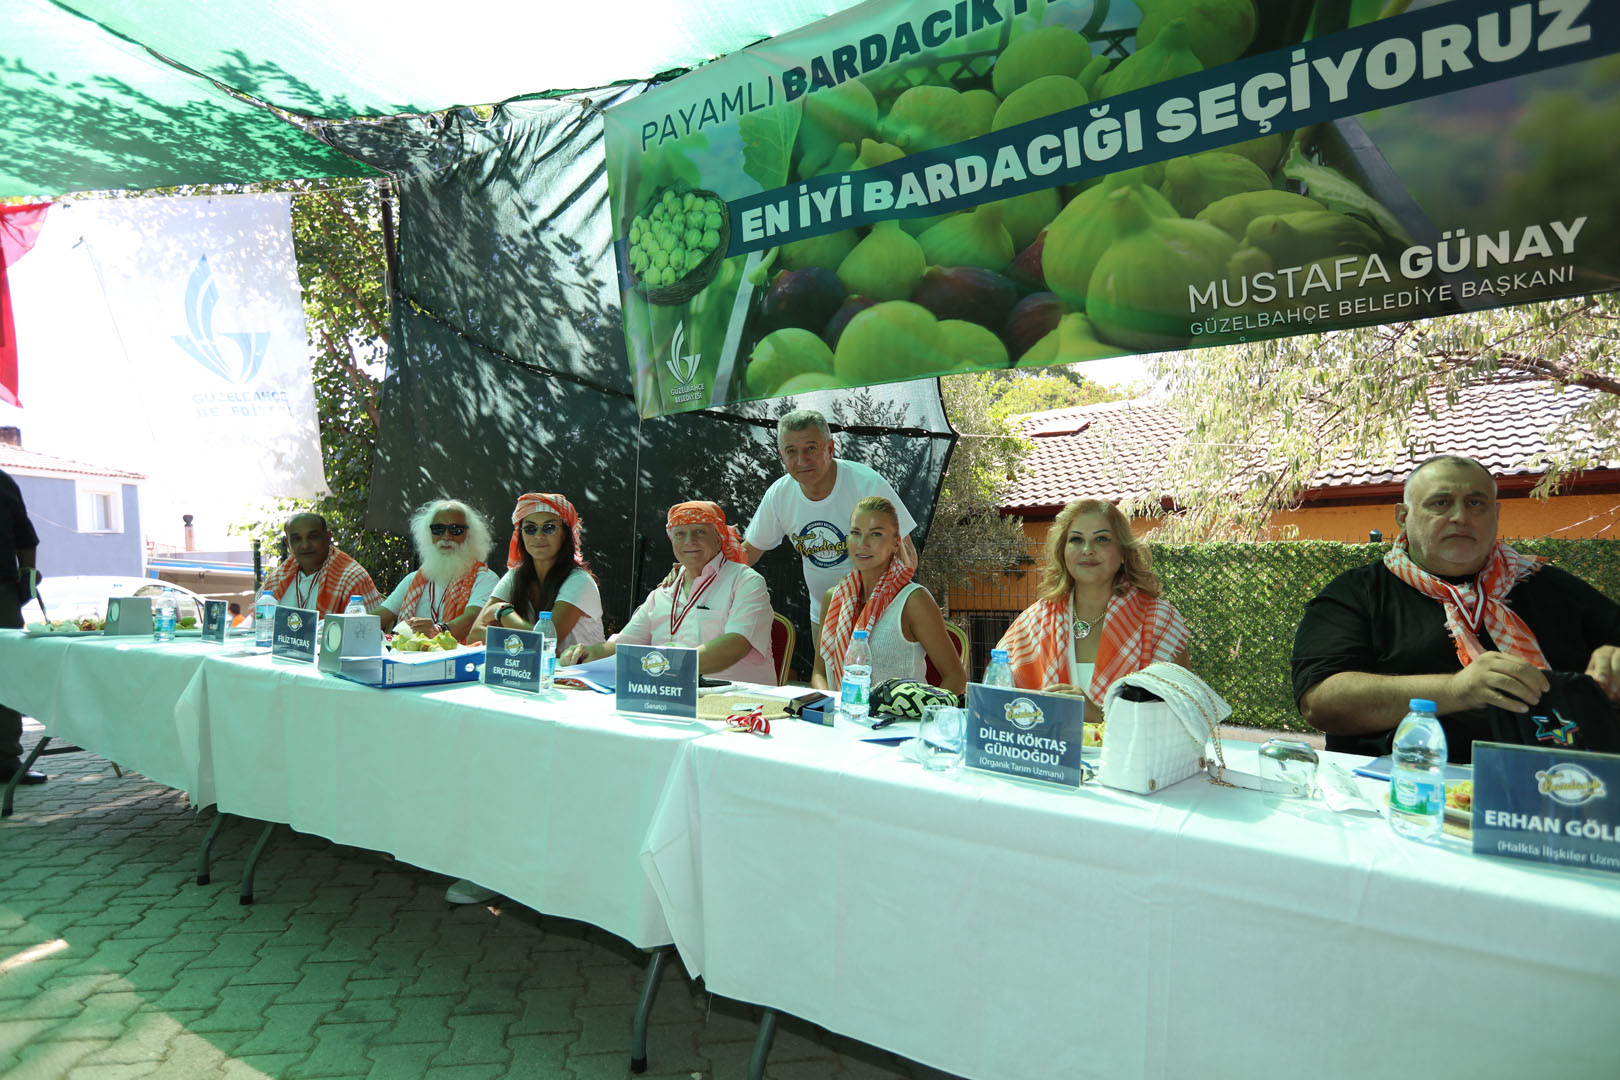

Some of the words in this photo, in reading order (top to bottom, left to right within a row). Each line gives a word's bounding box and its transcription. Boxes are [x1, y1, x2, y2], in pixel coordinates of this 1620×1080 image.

[642, 76, 774, 152] PAYAMLI
[782, 0, 1004, 102] BARDACIK
[741, 200, 790, 242] EN
[799, 175, 852, 228] İYİ
[863, 104, 1144, 213] BARDACIĞI
[1156, 0, 1591, 144] SEÇİYORUZ
[1188, 253, 1391, 313] MUSTAFA
[1400, 216, 1588, 280] GÜNAY
[1190, 304, 1330, 336] GÜZELBAHÇE
[1339, 284, 1452, 316] BELEDİYE
[1461, 265, 1574, 298] BAŞKANI
[493, 666, 532, 679] ERÇETİNGÖZ
[505, 658, 520, 667] ESAT
[628, 681, 658, 695] İVANA
[659, 685, 683, 697] SERT
[980, 726, 1014, 744] DİLEK
[1017, 733, 1067, 755] KÖKTAŞ
[984, 742, 1060, 766] GÜNDOĞDU
[979, 756, 1010, 769] (Organik
[1011, 762, 1032, 773] Tarım
[1033, 767, 1065, 780] Uzmanı)
[1484, 809, 1560, 834] ERHAN
[1497, 840, 1540, 855] (Halkla
